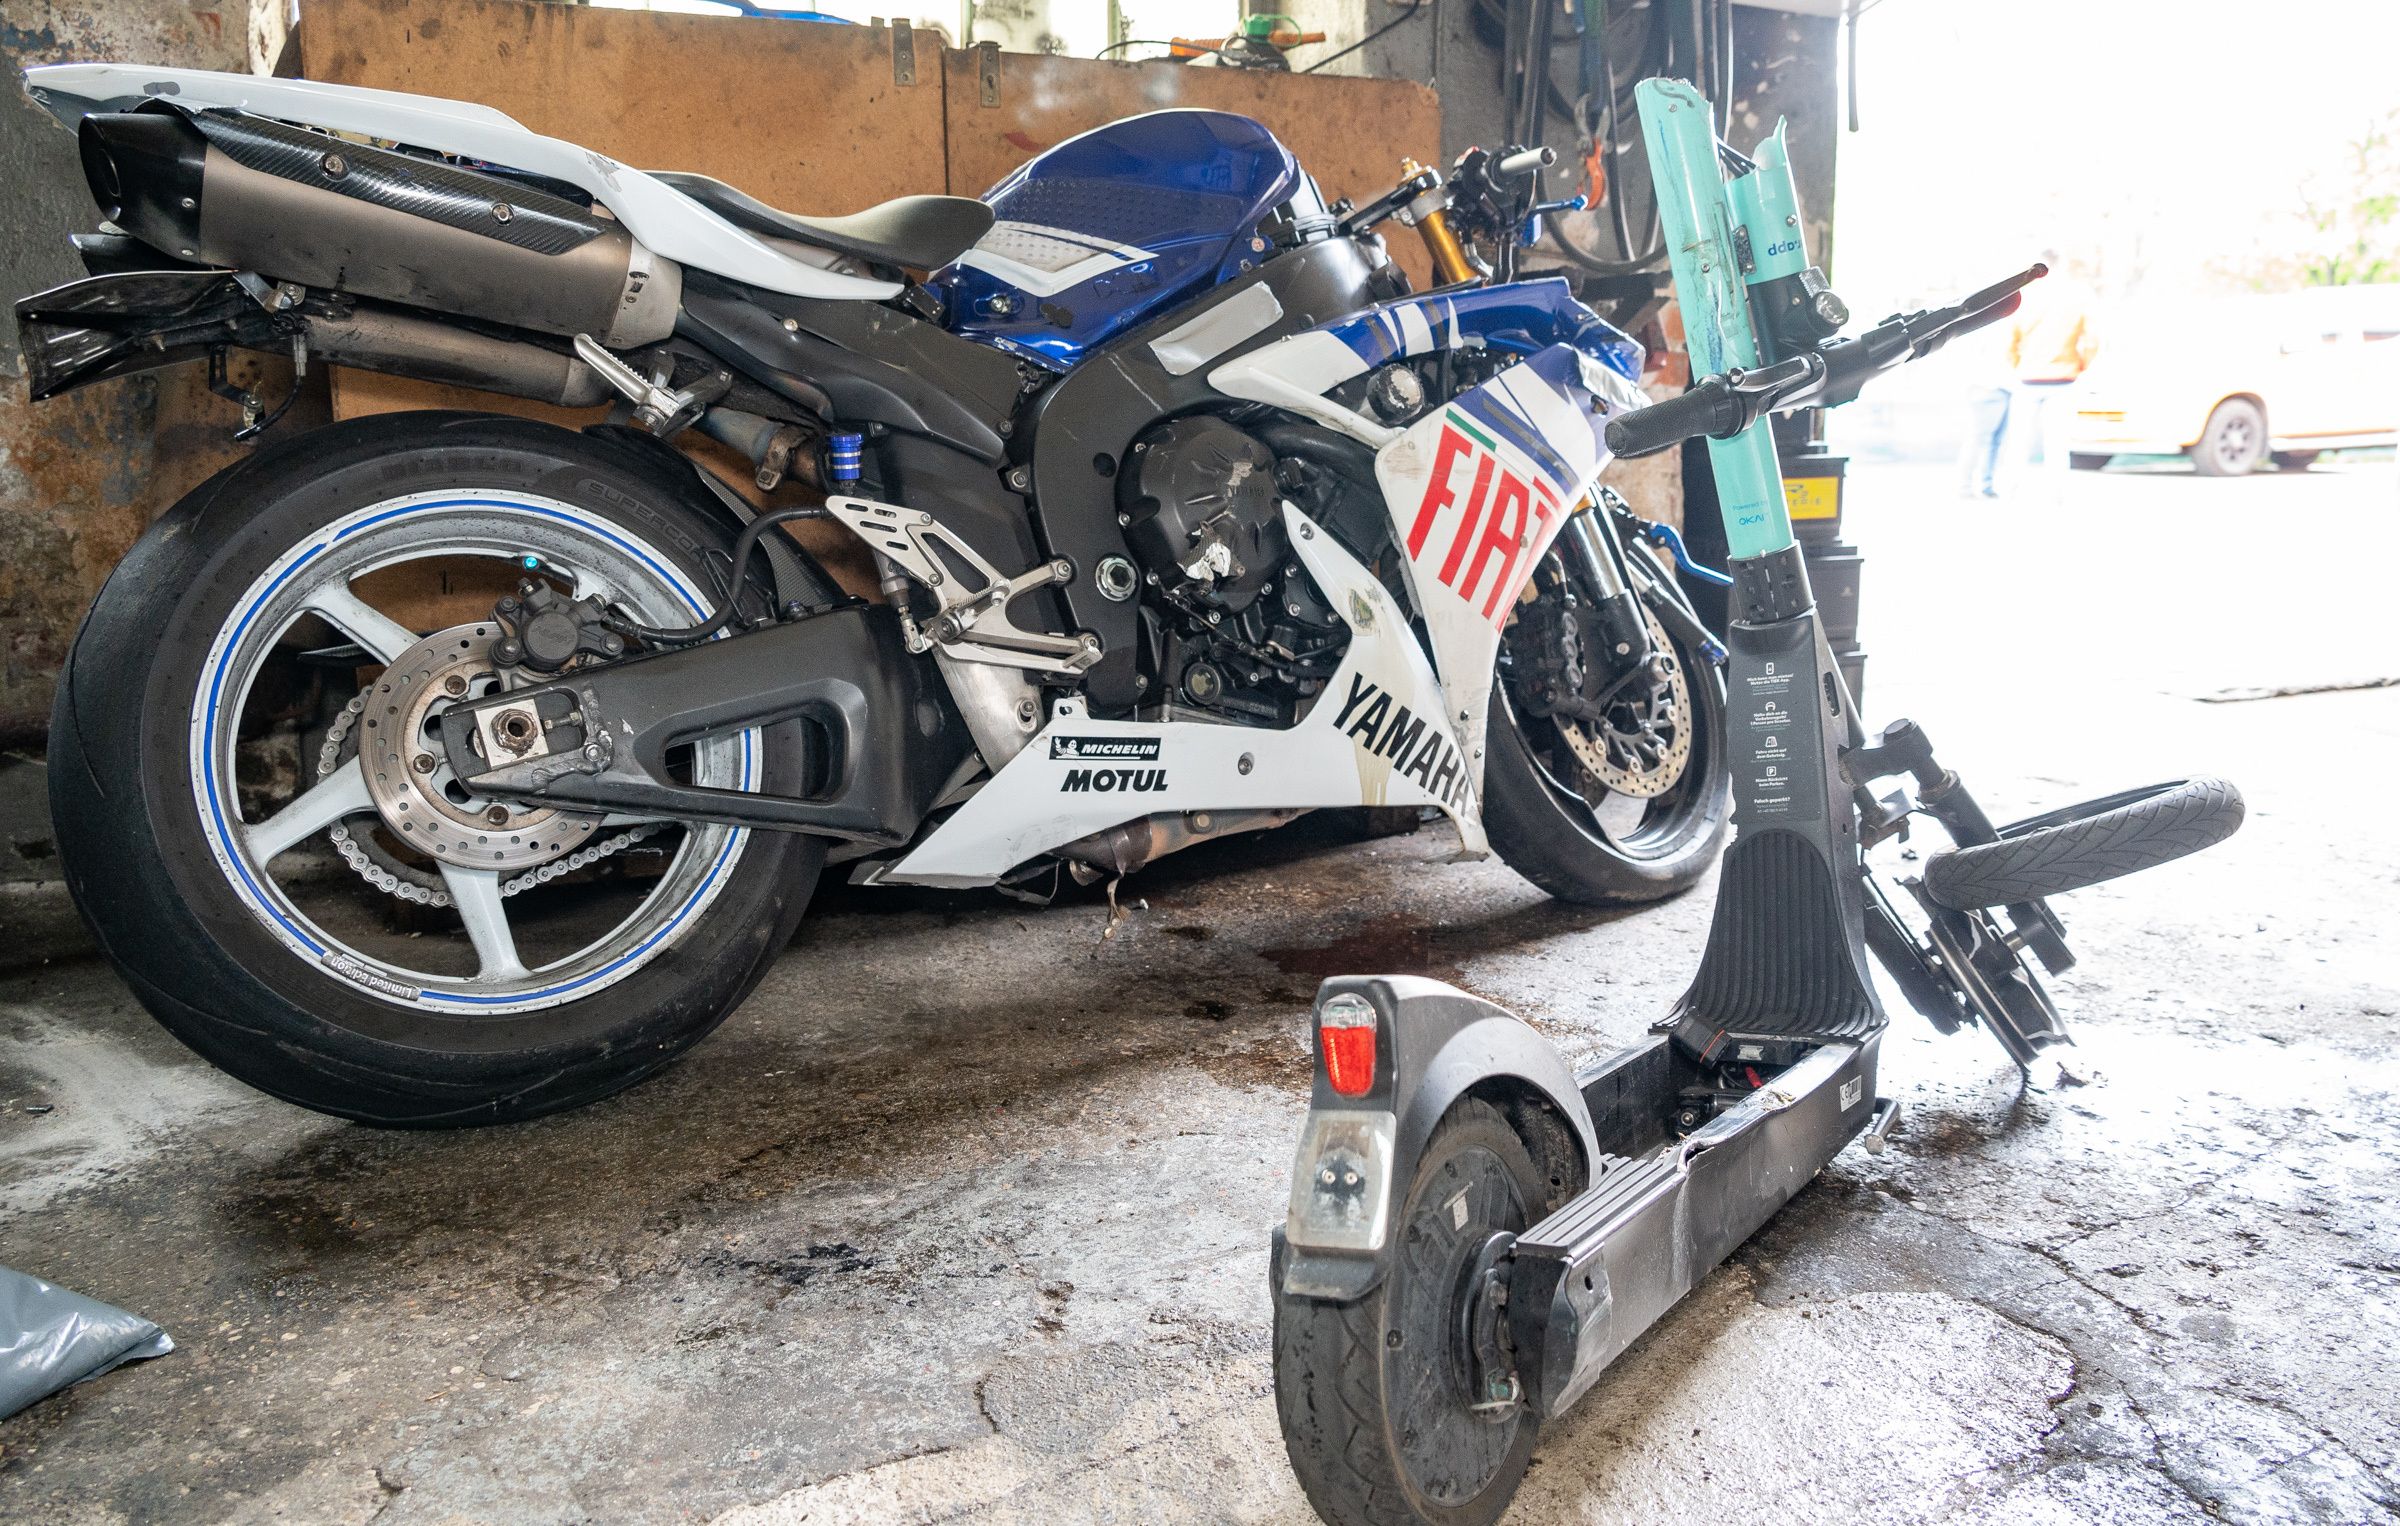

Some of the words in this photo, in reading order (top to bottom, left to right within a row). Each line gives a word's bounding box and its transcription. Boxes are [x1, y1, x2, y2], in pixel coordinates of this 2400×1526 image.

[1407, 424, 1562, 634] FIAT
[1081, 744, 1158, 755] MICHELIN
[1333, 672, 1469, 817] YAMAHA
[1060, 769, 1169, 793] MOTUL
[331, 955, 369, 984] Edition
[369, 978, 412, 998] Limited
